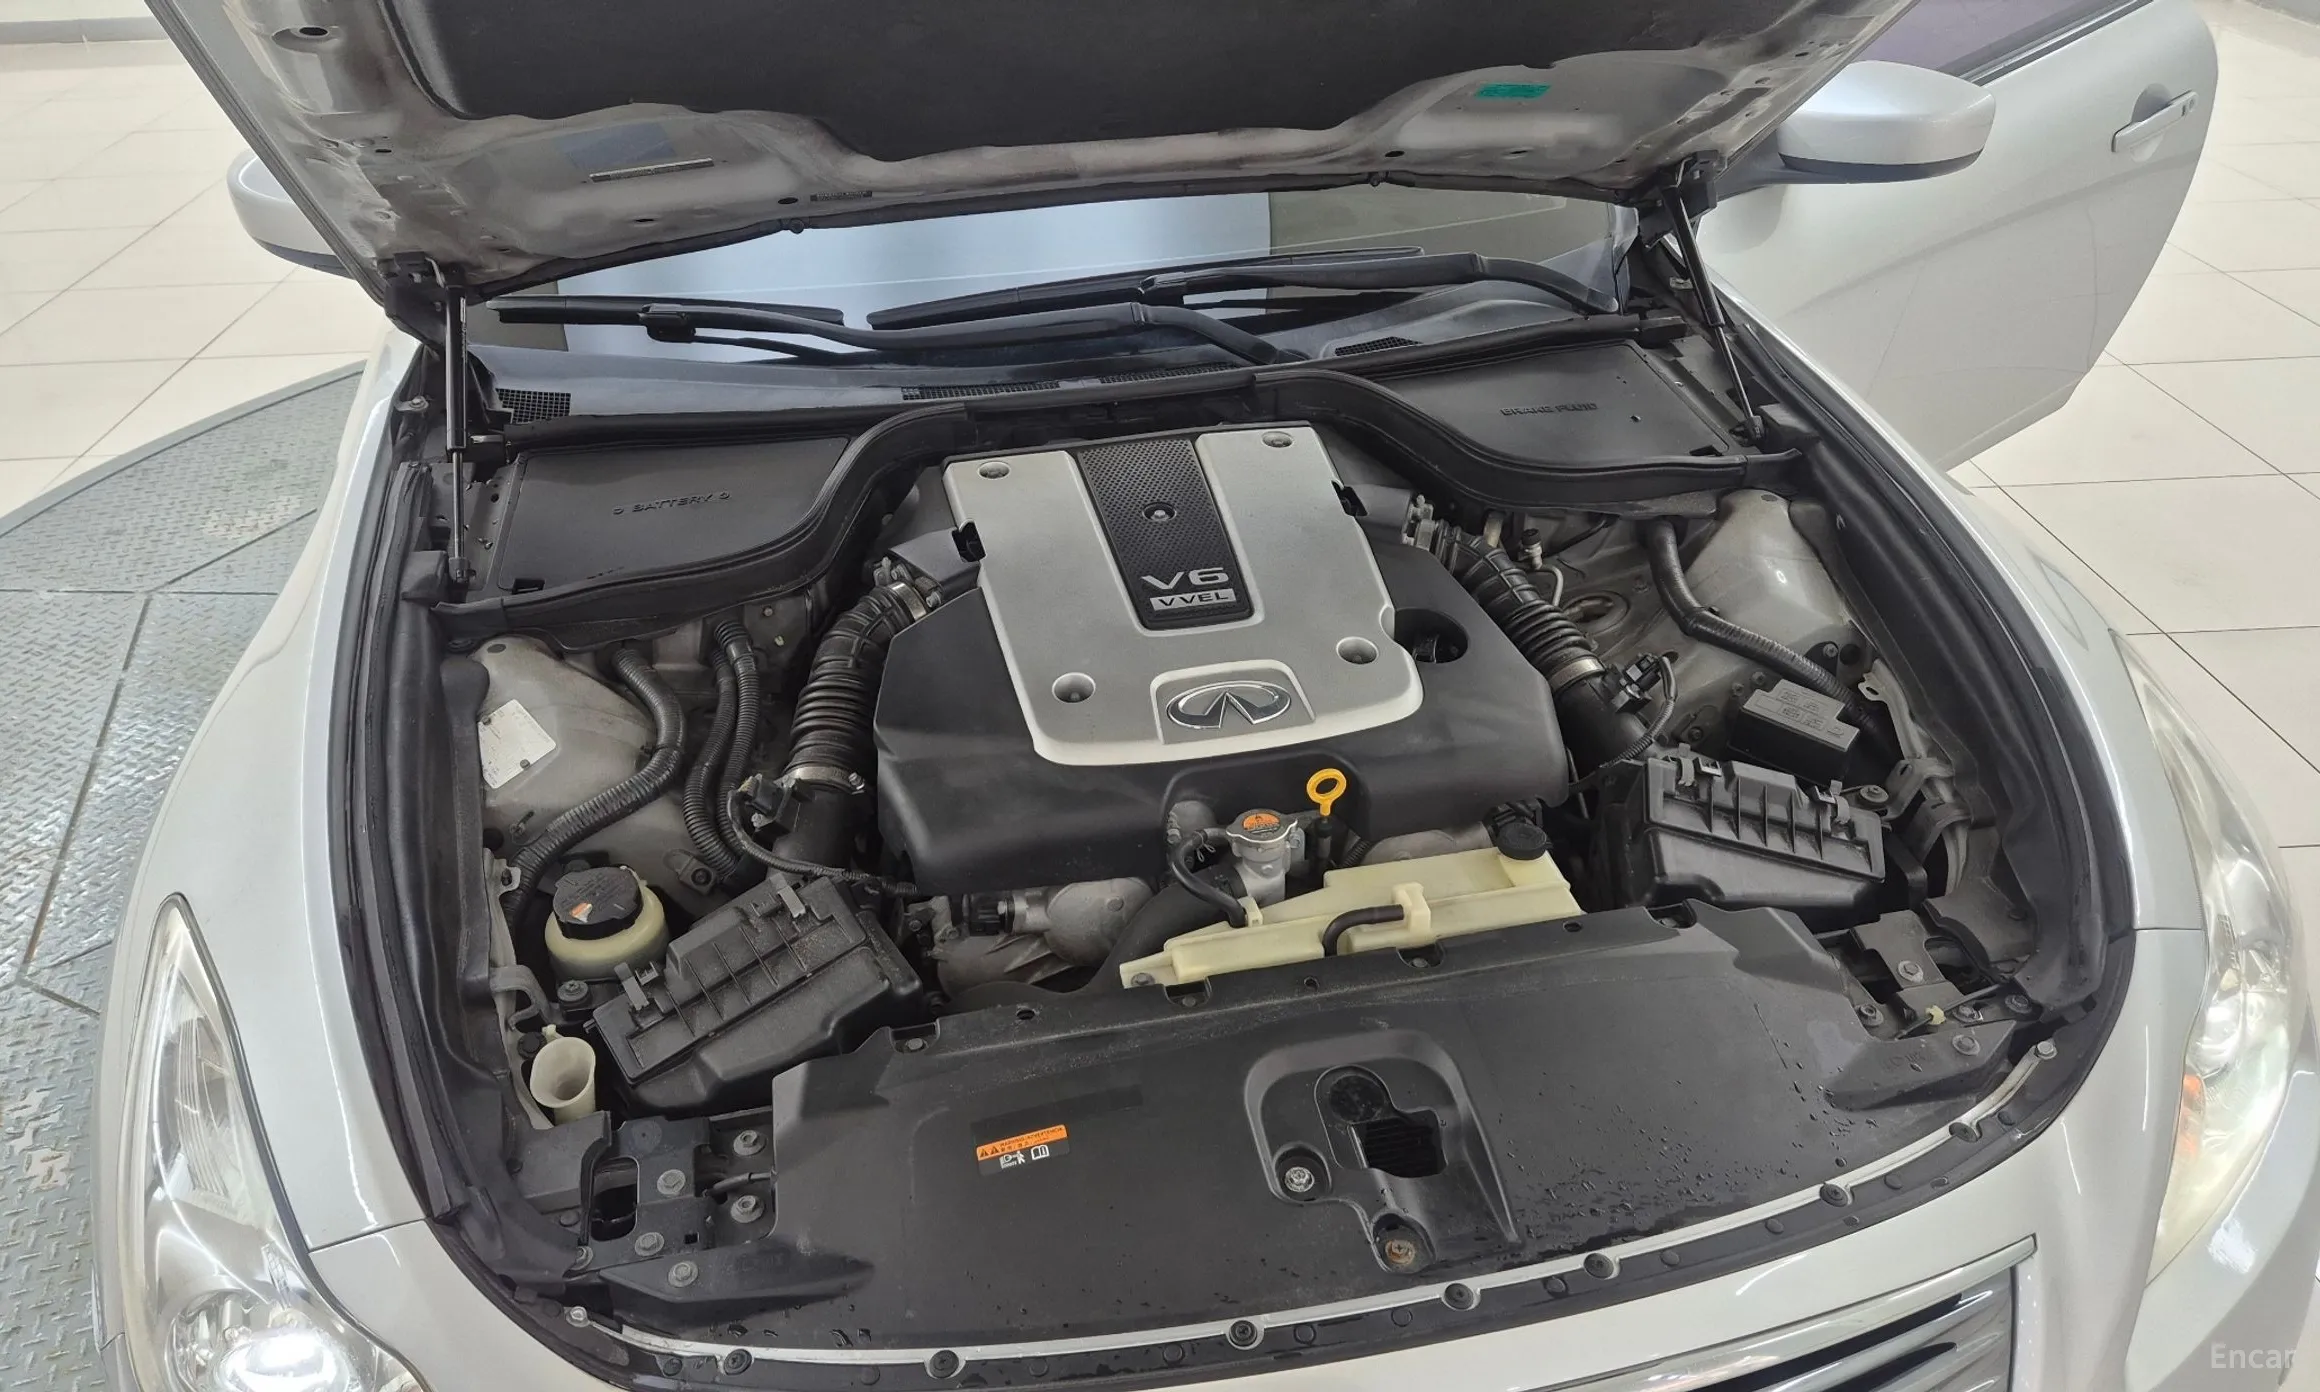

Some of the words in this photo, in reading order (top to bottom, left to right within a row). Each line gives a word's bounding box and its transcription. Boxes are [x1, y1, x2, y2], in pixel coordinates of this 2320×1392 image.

[1500, 406, 1555, 417] BRAKE
[1555, 402, 1599, 413] FLUID
[631, 493, 714, 513] BATTERY
[1141, 566, 1230, 590] V6
[1158, 591, 1229, 607] VVEL
